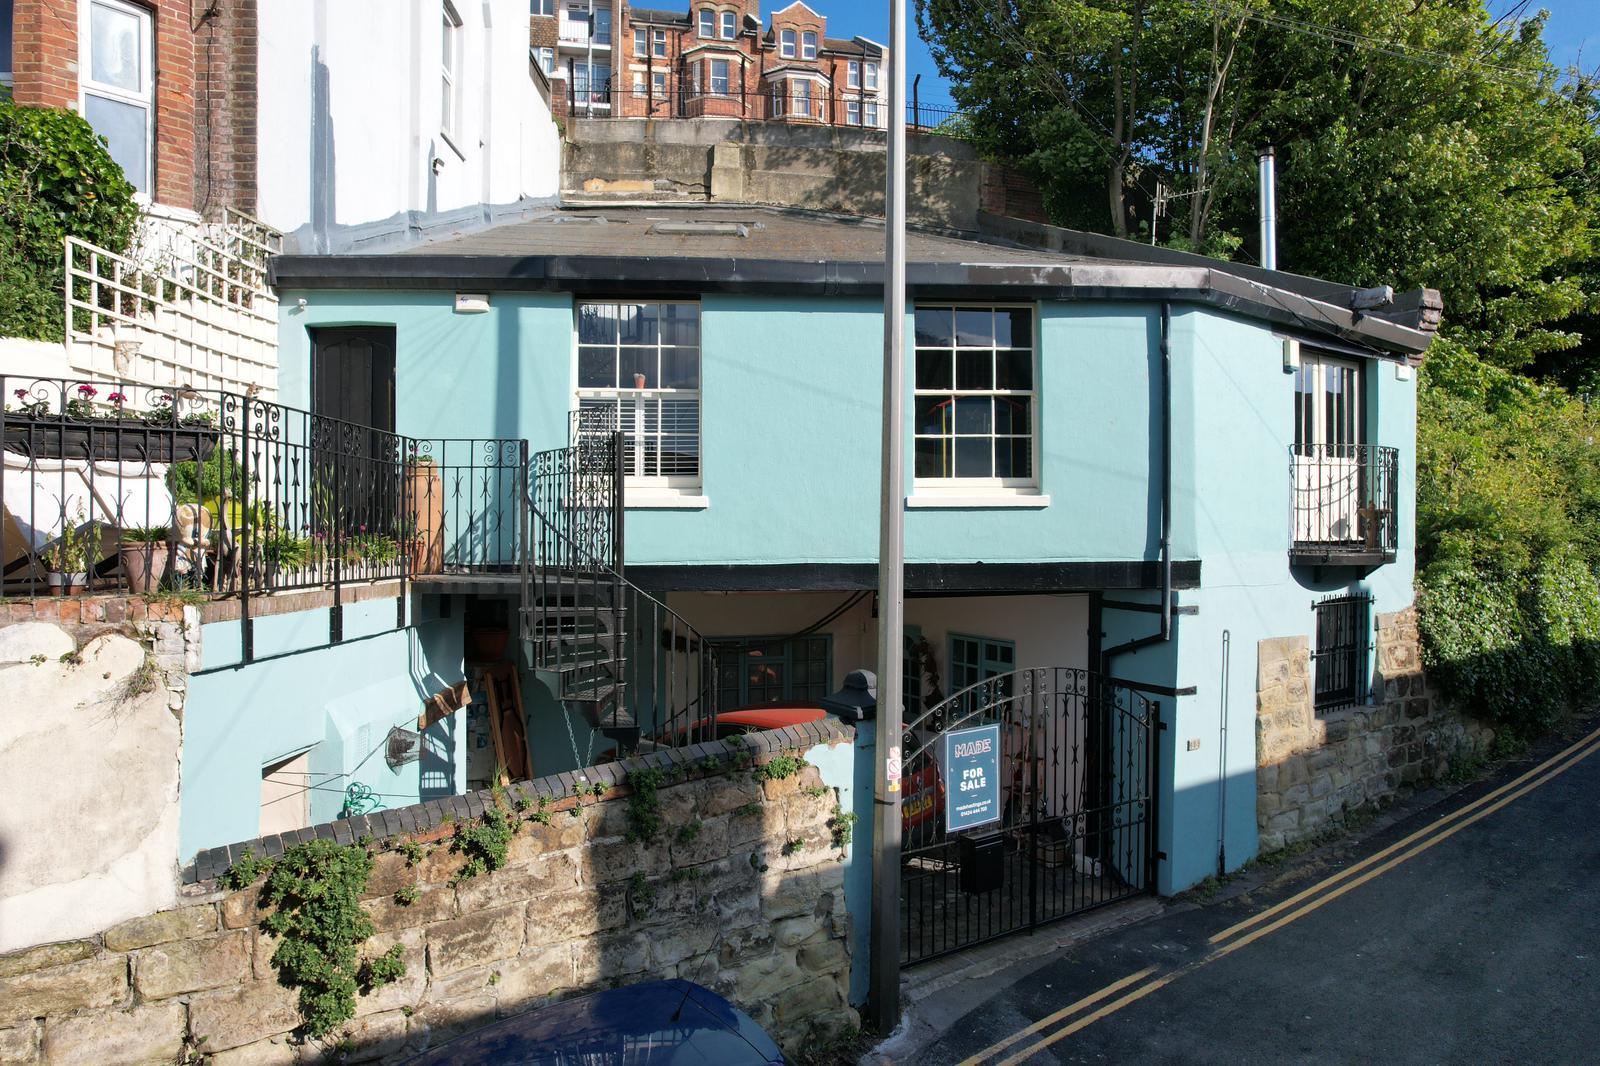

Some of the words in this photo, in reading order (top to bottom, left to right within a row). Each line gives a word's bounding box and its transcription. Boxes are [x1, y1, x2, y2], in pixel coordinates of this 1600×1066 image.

[955, 738, 991, 758] MADE
[963, 767, 983, 780] FOR
[960, 777, 986, 792] SALE
